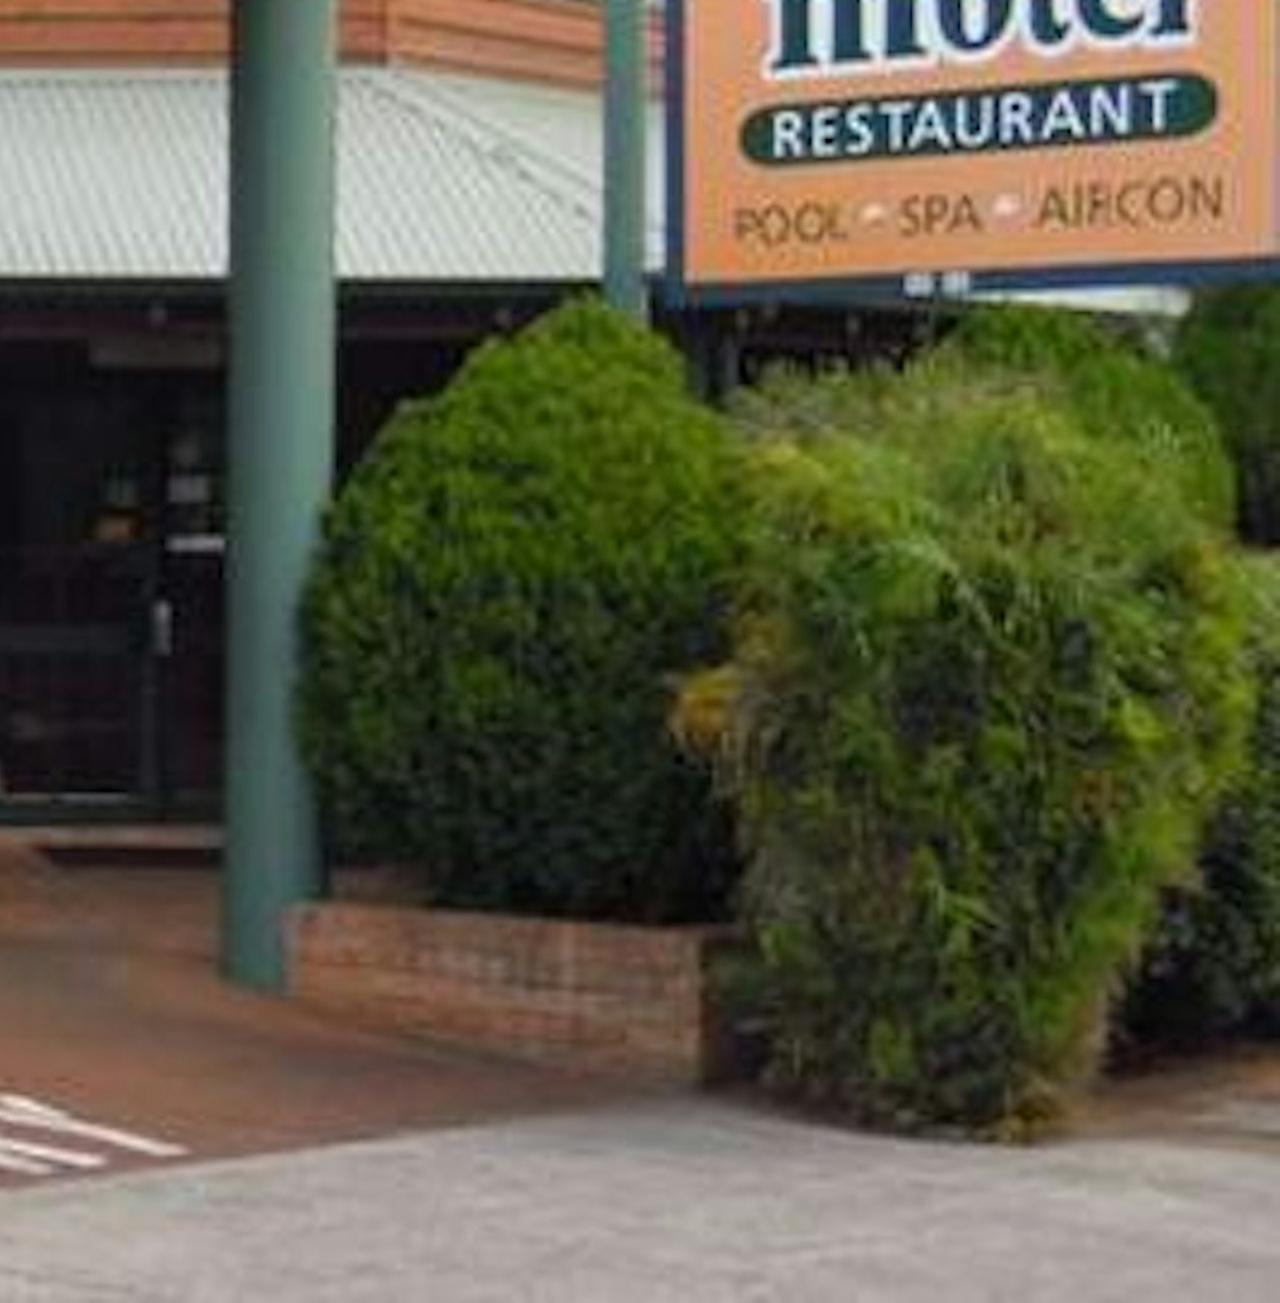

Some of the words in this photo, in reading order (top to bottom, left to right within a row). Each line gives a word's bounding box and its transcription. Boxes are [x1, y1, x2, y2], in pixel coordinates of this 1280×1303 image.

[771, 79, 1178, 158] RESTAURANT
[734, 201, 848, 250] POOL
[898, 193, 982, 239] SPA
[1038, 177, 1226, 229] AIRCON
